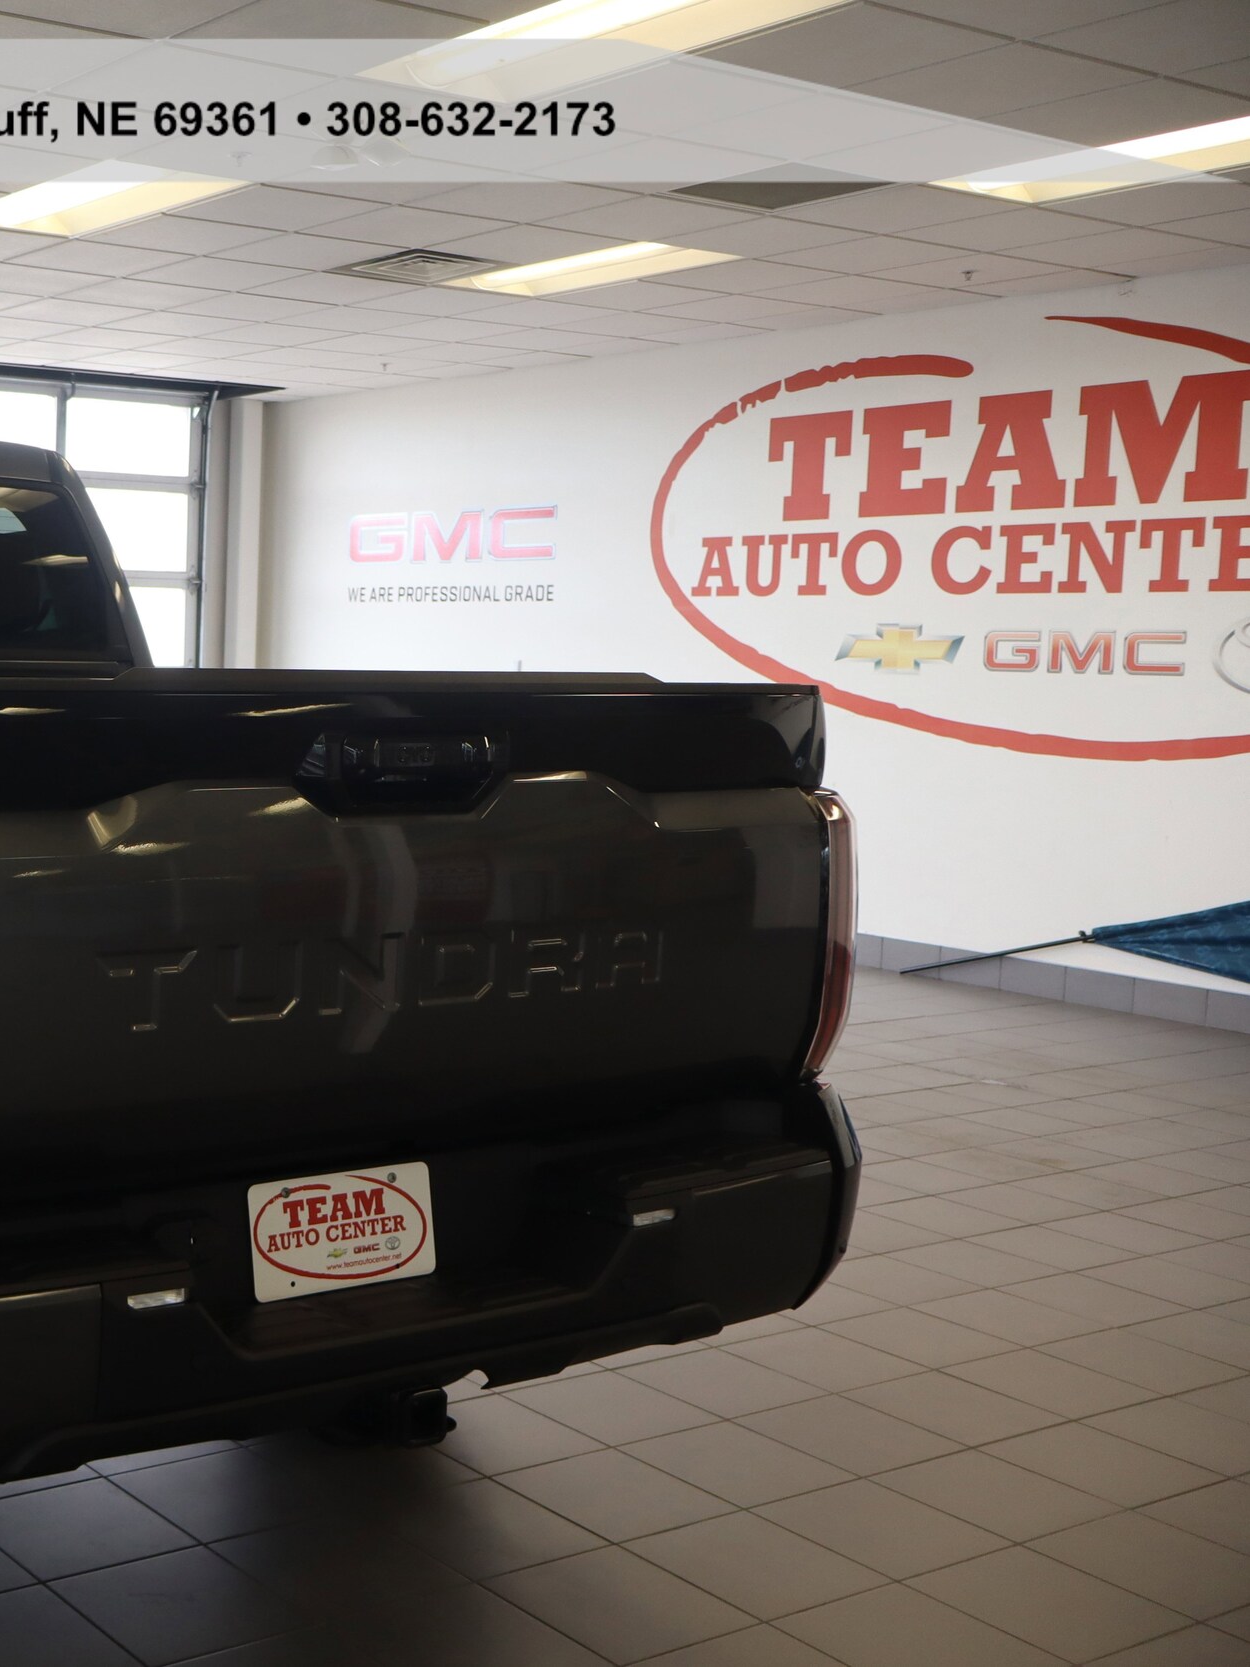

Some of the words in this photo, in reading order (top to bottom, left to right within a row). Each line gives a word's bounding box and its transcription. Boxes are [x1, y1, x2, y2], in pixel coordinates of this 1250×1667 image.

[768, 369, 1250, 522] TEAM
[350, 505, 558, 565] GMC
[691, 529, 903, 597] AUTO
[931, 515, 1250, 596] CENTE
[348, 586, 367, 602] WE
[370, 586, 394, 602] ARE
[398, 585, 500, 602] PROFESSIONAL
[504, 584, 555, 602] GRADE
[982, 629, 1188, 676] GMC
[96, 926, 666, 1032] TUNDRA
[282, 1187, 386, 1229] TEAM
[267, 1229, 320, 1253] AUTO
[325, 1214, 407, 1243] CENTER
[353, 1243, 380, 1254] GMC
